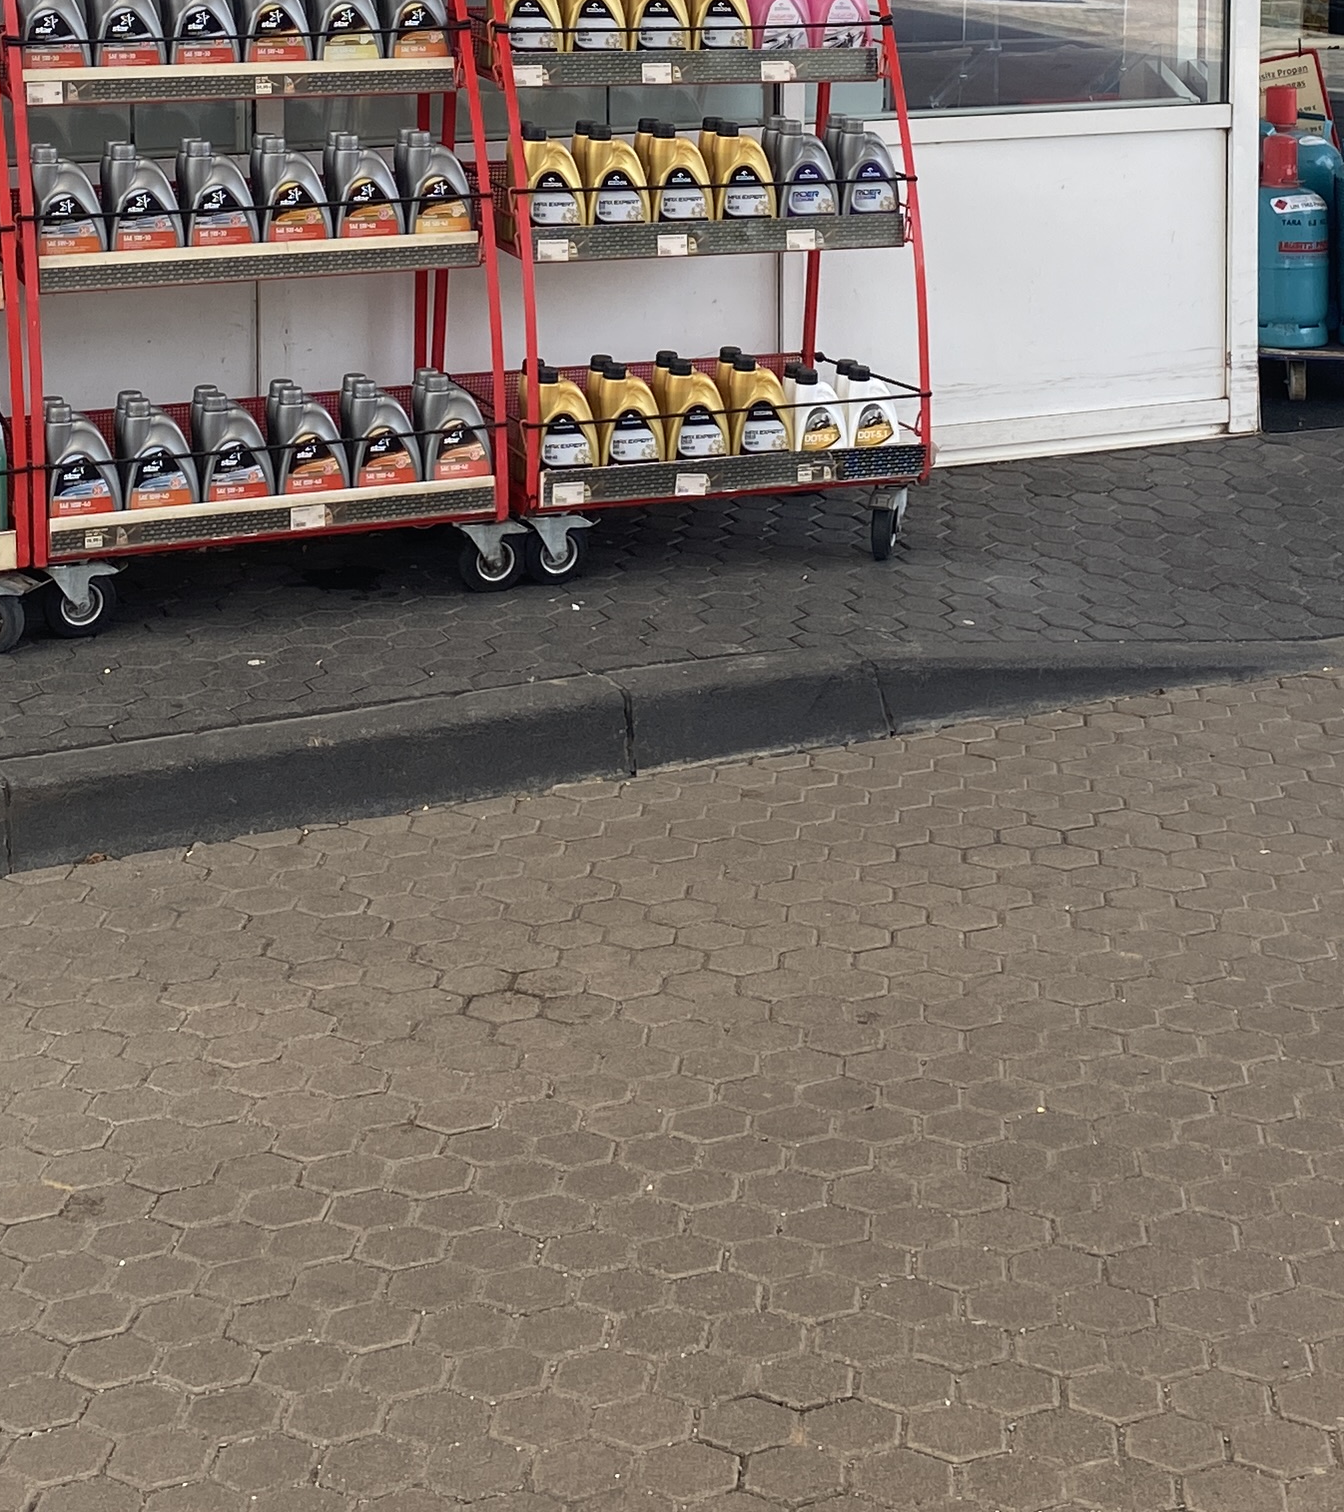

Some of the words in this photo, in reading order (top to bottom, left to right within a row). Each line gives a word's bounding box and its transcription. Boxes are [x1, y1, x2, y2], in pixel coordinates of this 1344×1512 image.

[188, 22, 204, 30] star
[261, 20, 277, 28] star
[35, 26, 52, 34] star
[1277, 64, 1309, 78] Propan
[804, 434, 836, 443] DOT-5.1
[857, 430, 888, 439] DOT-5.1
[443, 436, 459, 444] star
[369, 444, 387, 452] star
[296, 450, 314, 459] star
[220, 458, 239, 467] star
[142, 464, 161, 473] star
[63, 471, 81, 480] star
